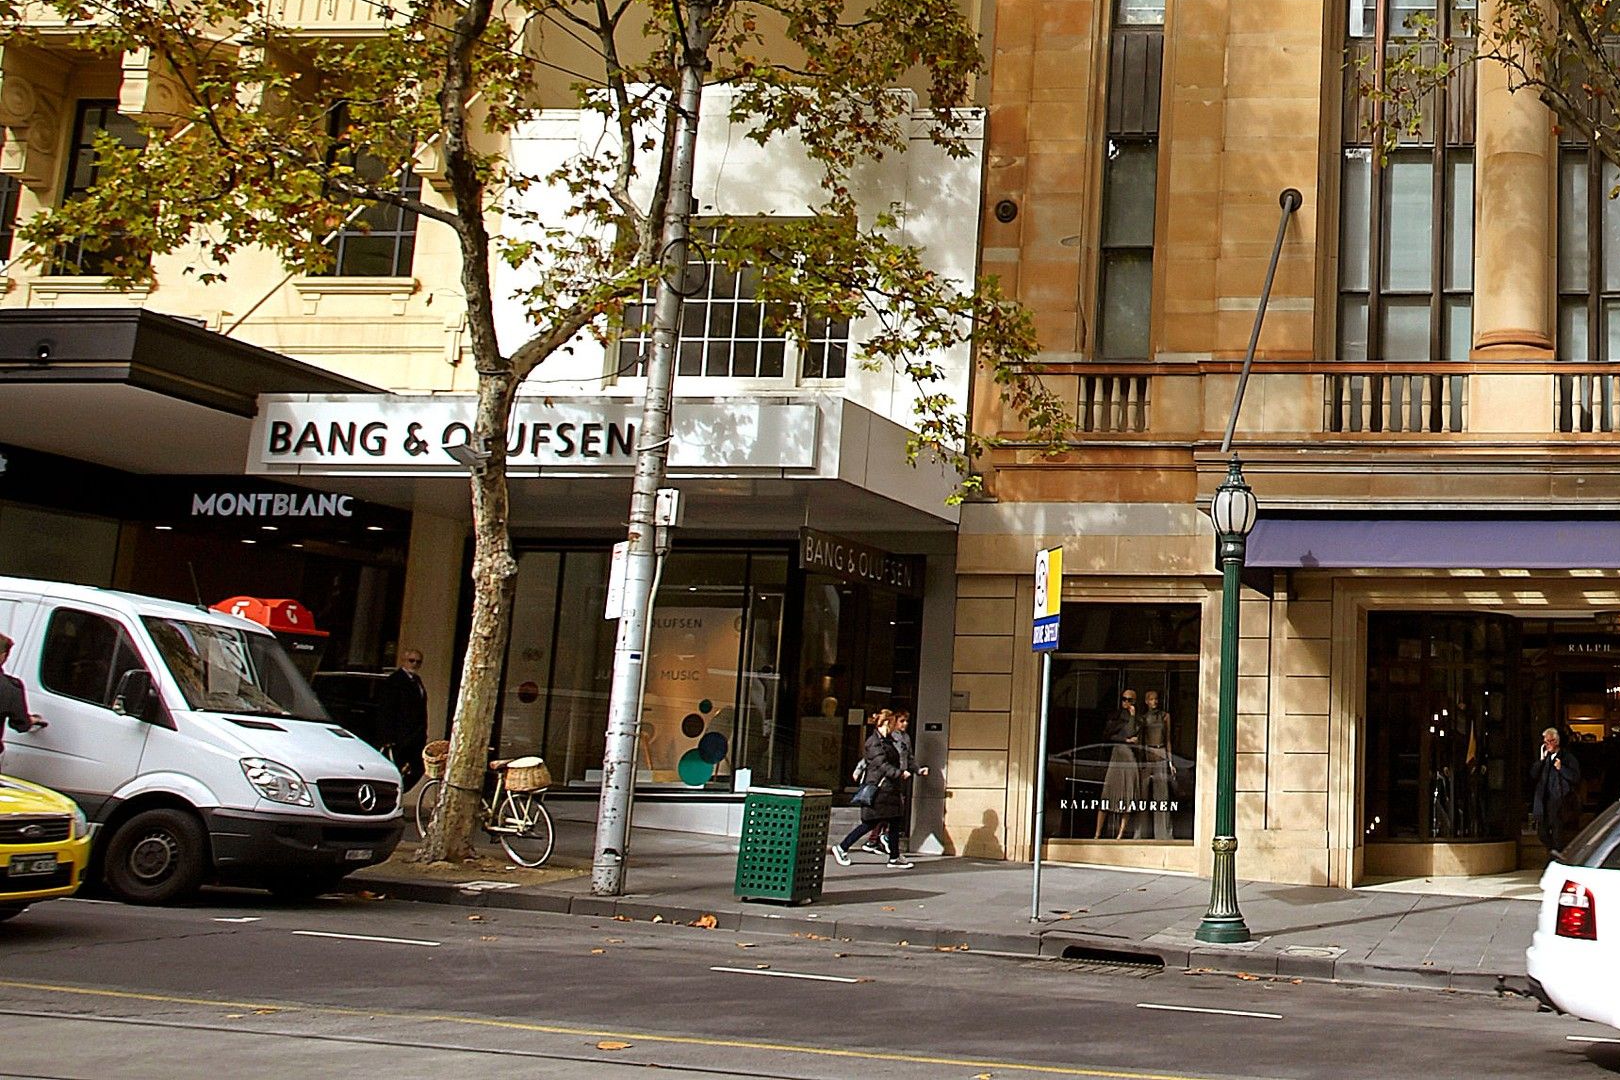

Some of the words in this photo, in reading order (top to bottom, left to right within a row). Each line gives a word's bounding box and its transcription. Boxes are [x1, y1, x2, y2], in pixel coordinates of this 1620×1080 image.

[268, 421, 388, 456] BANG
[403, 421, 430, 456] &
[441, 421, 636, 457] OUFSEN
[191, 493, 354, 517] MONTBLANC
[806, 536, 843, 571] BANG
[847, 548, 855, 573] &
[1568, 643, 1610, 652] RALPH
[661, 670, 701, 681] MUSIC
[1060, 799, 1110, 811] RALPH
[1119, 800, 1179, 812] LAUREN
